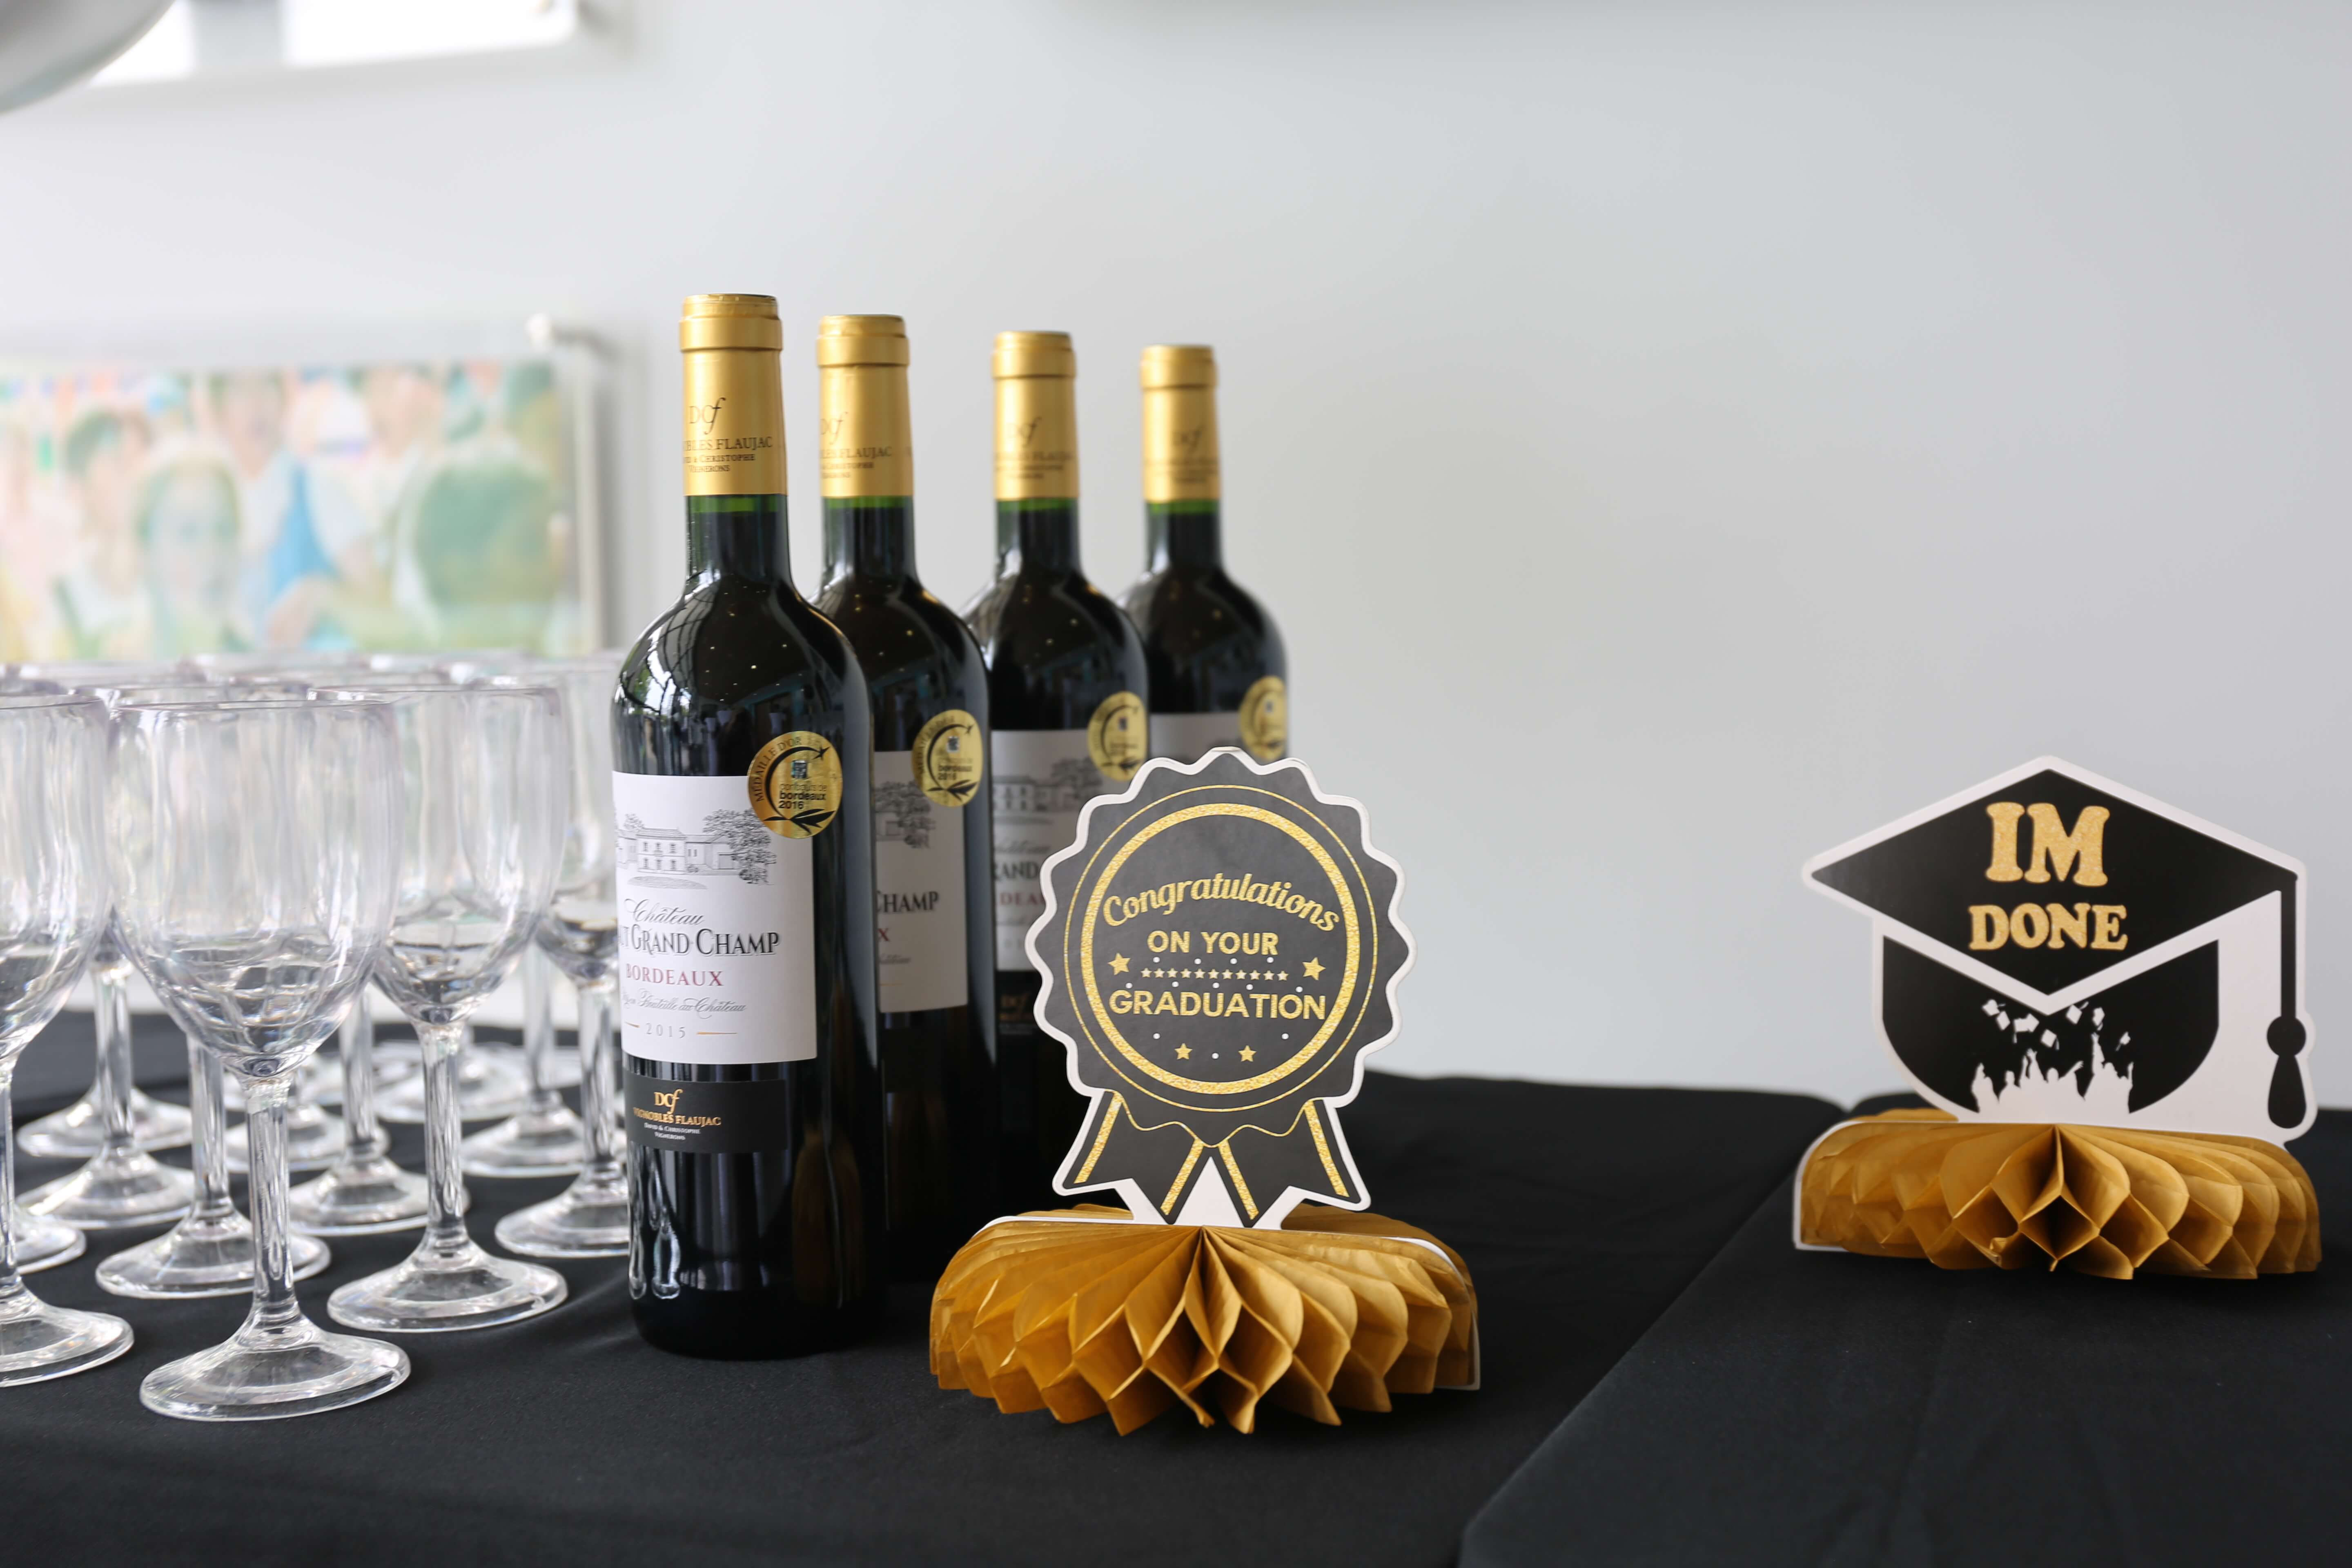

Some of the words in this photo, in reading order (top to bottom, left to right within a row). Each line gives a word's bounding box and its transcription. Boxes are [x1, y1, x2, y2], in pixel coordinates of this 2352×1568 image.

[716, 437, 773, 450] FLAUJAC
[779, 790, 826, 800] bordeaux
[779, 800, 804, 809] 2016
[1985, 801, 2110, 887] IM
[624, 898, 705, 925] Château
[1103, 873, 1340, 931] Congratulations
[1968, 902, 2128, 951] DONE
[630, 924, 690, 956] GRAND
[696, 928, 781, 955] CHAMP
[1147, 930, 1190, 953] ON
[1200, 932, 1279, 955] YOUR
[626, 963, 725, 986] BORDEAUX
[1109, 990, 1326, 1020] GRADUATION
[646, 1023, 686, 1039] 2015
[633, 1107, 674, 1124] VIGNOBLES
[675, 1115, 722, 1127] FLAUJAC
